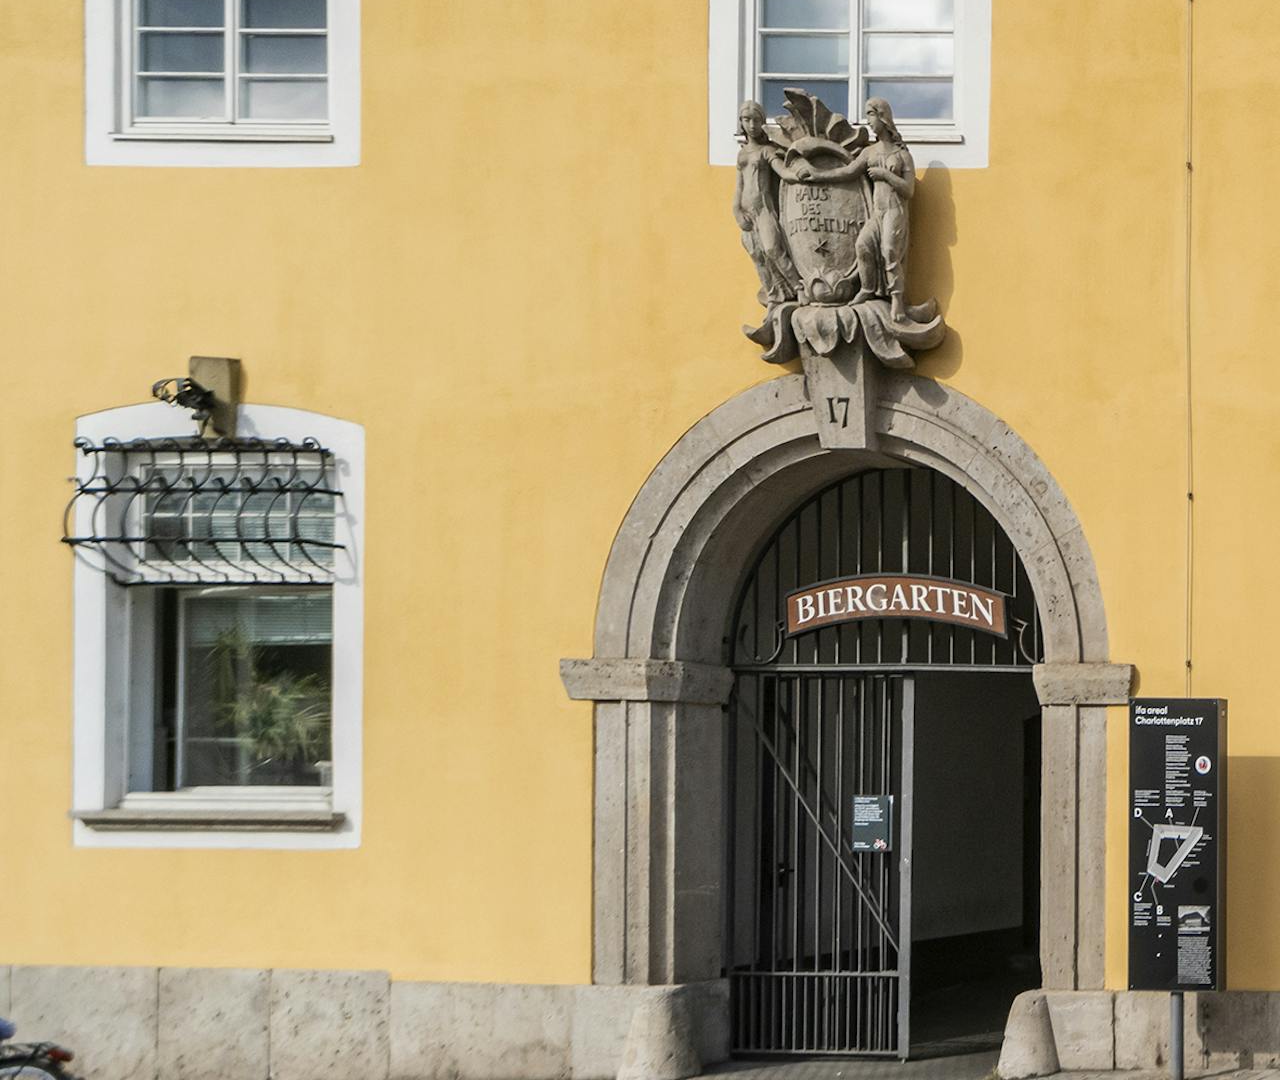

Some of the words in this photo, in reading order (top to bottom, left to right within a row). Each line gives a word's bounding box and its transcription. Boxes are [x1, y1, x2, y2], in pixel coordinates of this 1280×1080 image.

[801, 203, 821, 216] DES
[826, 397, 850, 429] 17
[796, 582, 994, 626] BIERGARTEN
[1147, 705, 1168, 715] areal
[1135, 716, 1194, 727] Charlottenplatz
[1194, 717, 1204, 726] 17
[1133, 808, 1143, 818] D
[1164, 808, 1174, 819] A
[1133, 892, 1142, 902] C
[1156, 905, 1164, 915] B
